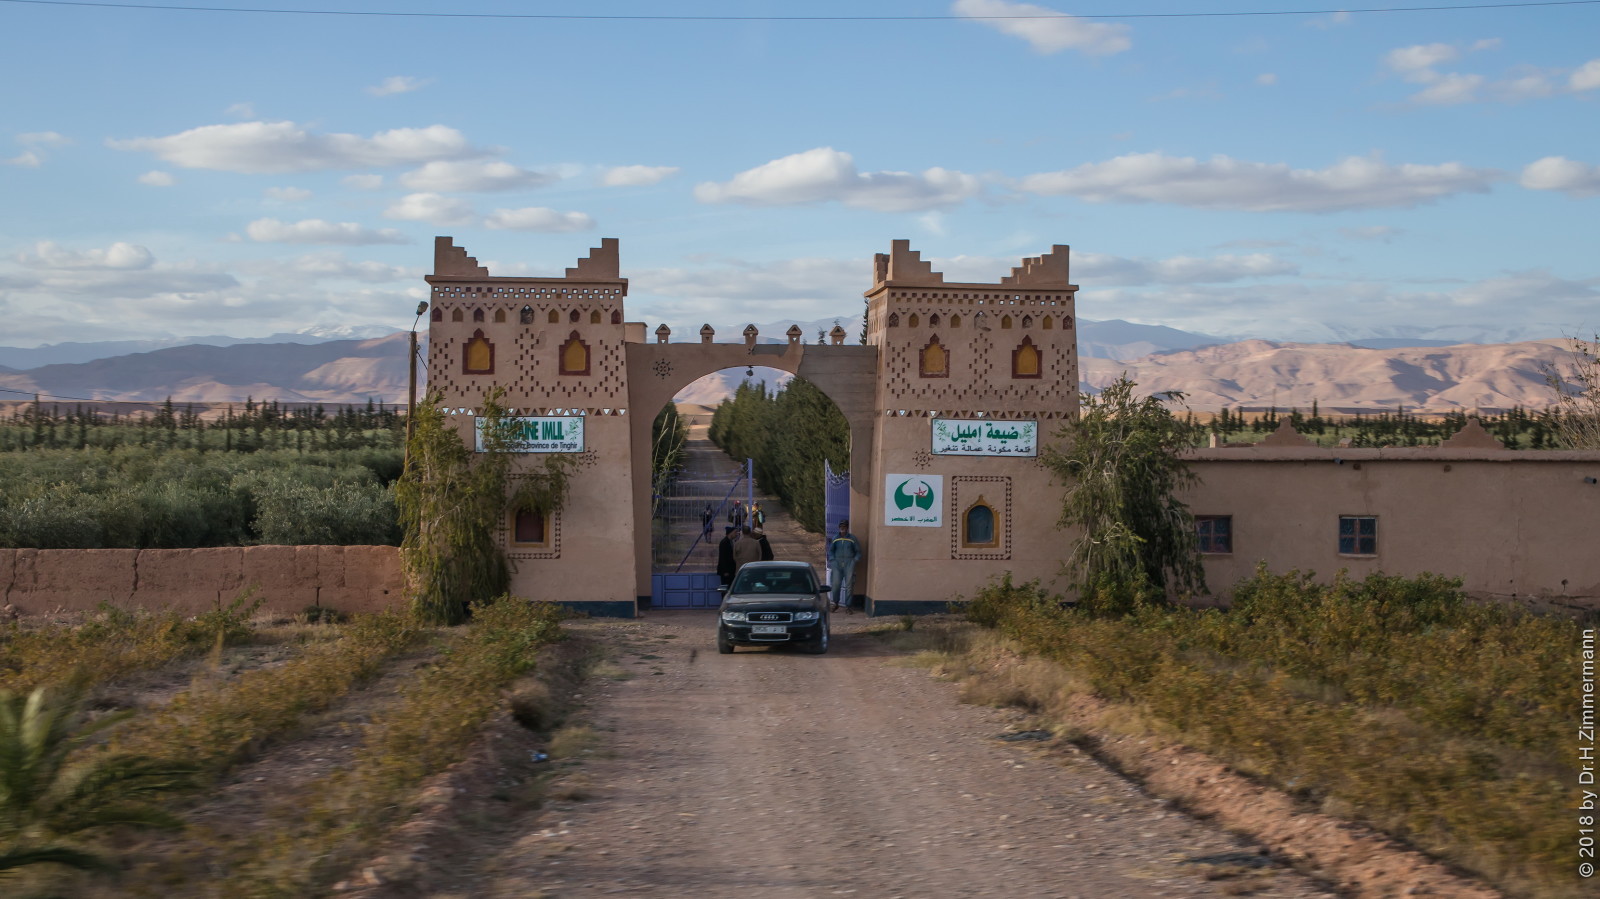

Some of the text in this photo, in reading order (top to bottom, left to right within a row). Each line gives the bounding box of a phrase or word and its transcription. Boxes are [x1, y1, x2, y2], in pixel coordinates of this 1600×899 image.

[542, 421, 565, 440] IMLIL
[951, 422, 1019, 444] ضيعة إمليل
[551, 441, 559, 449] de
[560, 441, 578, 450] Tinghir
